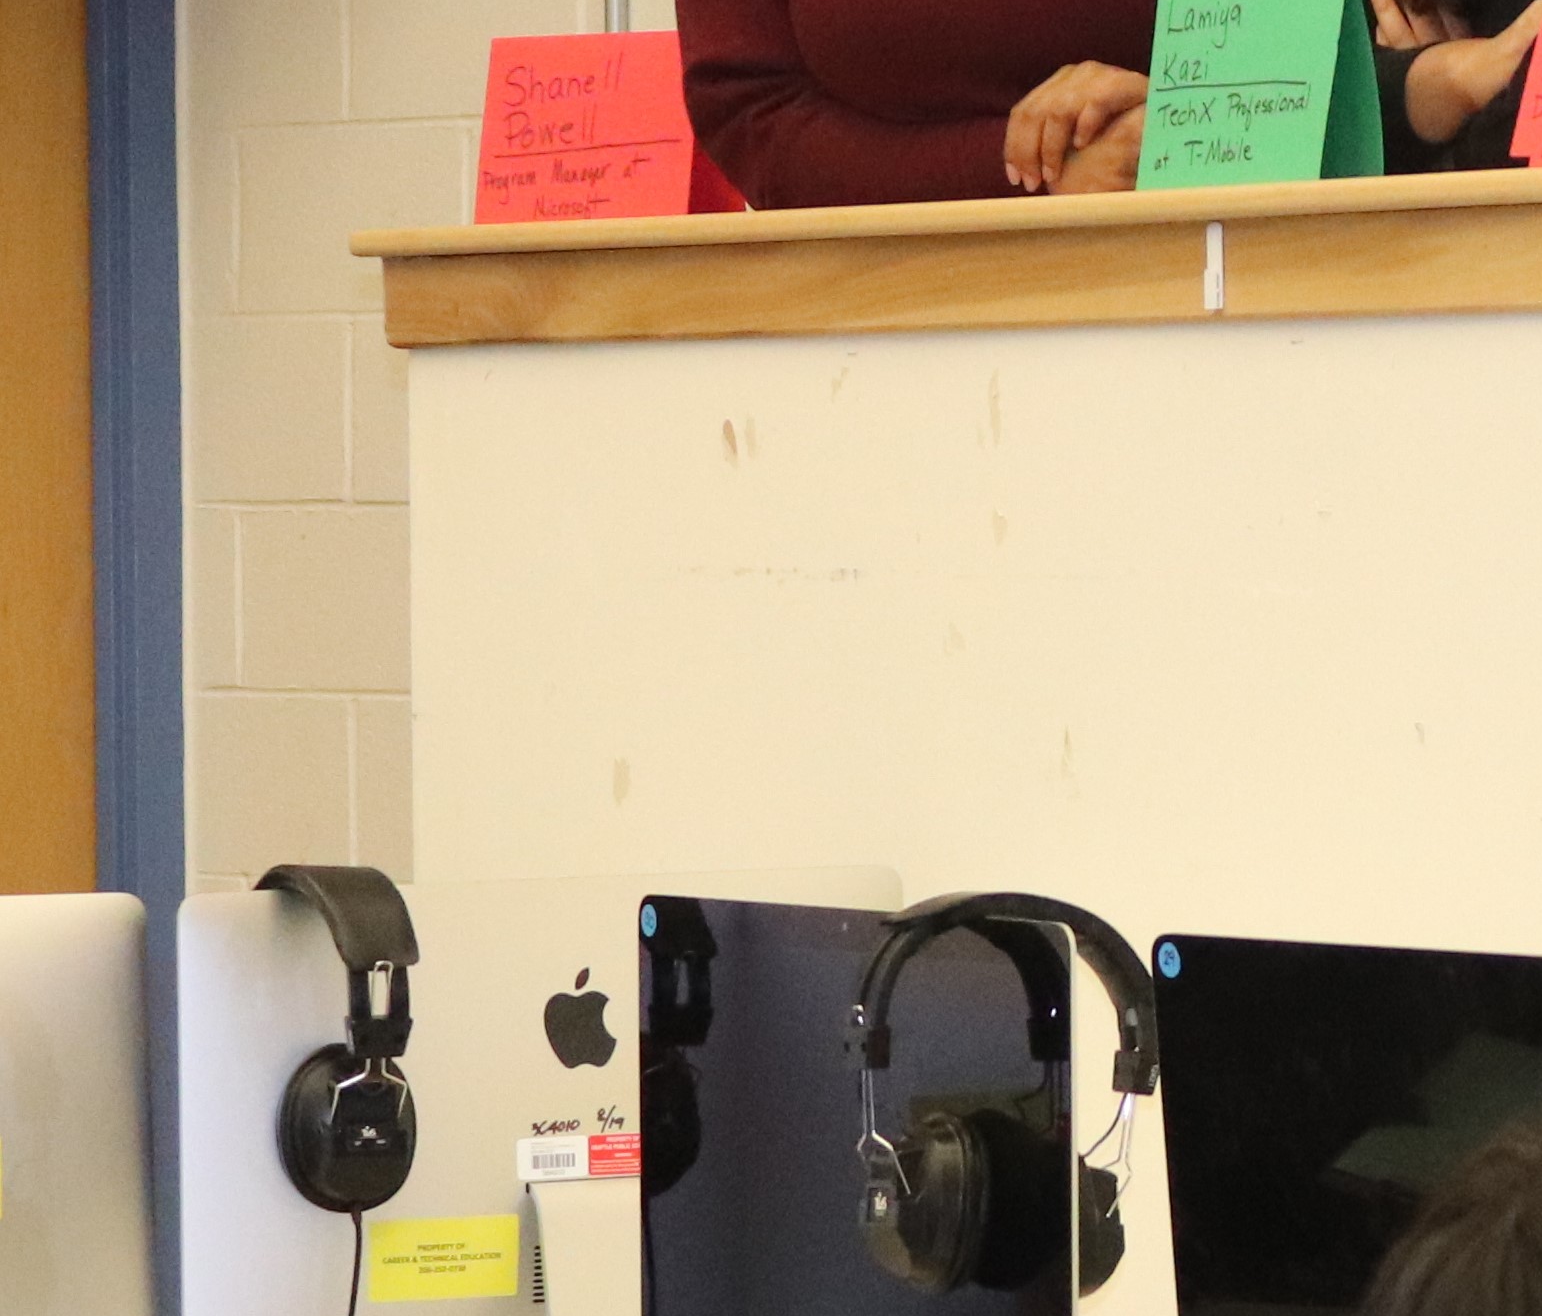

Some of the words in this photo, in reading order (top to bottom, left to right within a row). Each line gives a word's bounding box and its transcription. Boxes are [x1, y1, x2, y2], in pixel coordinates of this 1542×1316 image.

[503, 52, 624, 107] Shanell
[1163, 51, 1209, 85] Kazi
[504, 104, 597, 149] Powell
[1227, 84, 1311, 131] Professional
[1154, 153, 1169, 171] at
[1184, 137, 1254, 166] T-Mobile
[482, 170, 537, 205] Program
[552, 158, 612, 187] Manager
[623, 152, 651, 178] at
[534, 191, 611, 218] Microsoft
[417, 1243, 454, 1252] PROPERTY
